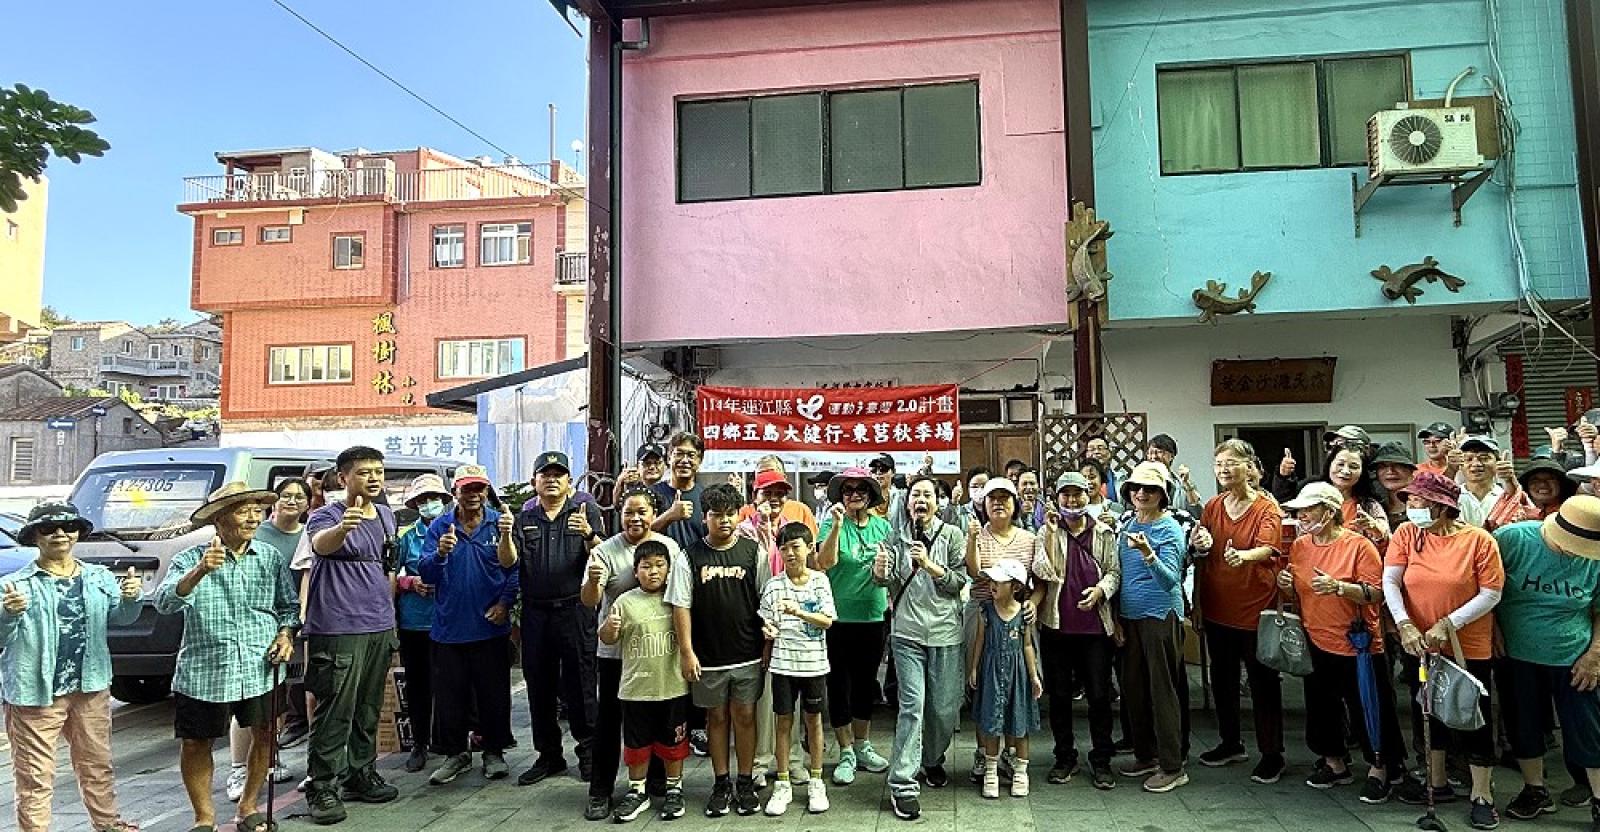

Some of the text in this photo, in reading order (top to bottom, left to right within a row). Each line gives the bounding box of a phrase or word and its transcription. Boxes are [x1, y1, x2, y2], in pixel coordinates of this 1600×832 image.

[1444, 113, 1470, 123] SAPO
[371, 311, 397, 395] 楓樹林
[702, 395, 793, 416] 114年連江縣
[702, 422, 955, 445] 四鄉五島大健行-東莒秋季場
[1521, 574, 1587, 600] Hello
